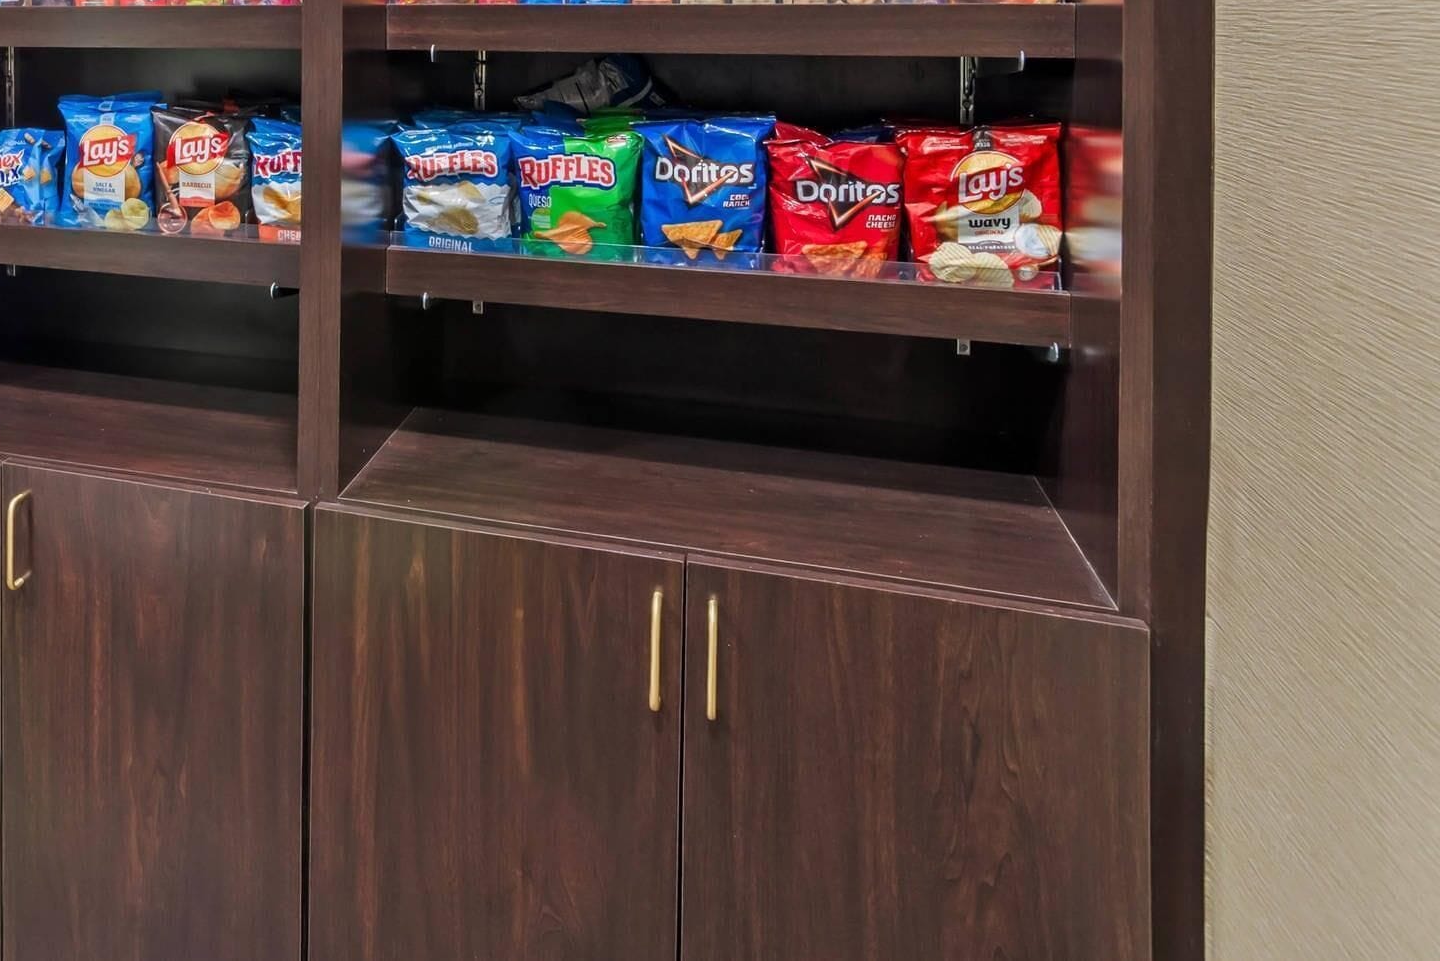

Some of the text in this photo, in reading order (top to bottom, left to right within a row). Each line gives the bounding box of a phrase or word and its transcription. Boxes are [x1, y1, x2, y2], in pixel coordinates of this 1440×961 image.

[83, 136, 129, 166] Lay's
[405, 151, 497, 182] RUFFLES
[518, 154, 615, 189] RUFFLES
[655, 156, 754, 183] Doritos
[796, 180, 900, 204] Doritos
[959, 163, 1024, 203] Lay's
[528, 193, 552, 208] QUESO
[865, 221, 896, 229] CHEESE
[968, 218, 1011, 229] wavy
[428, 236, 473, 252] ORIGINAL
